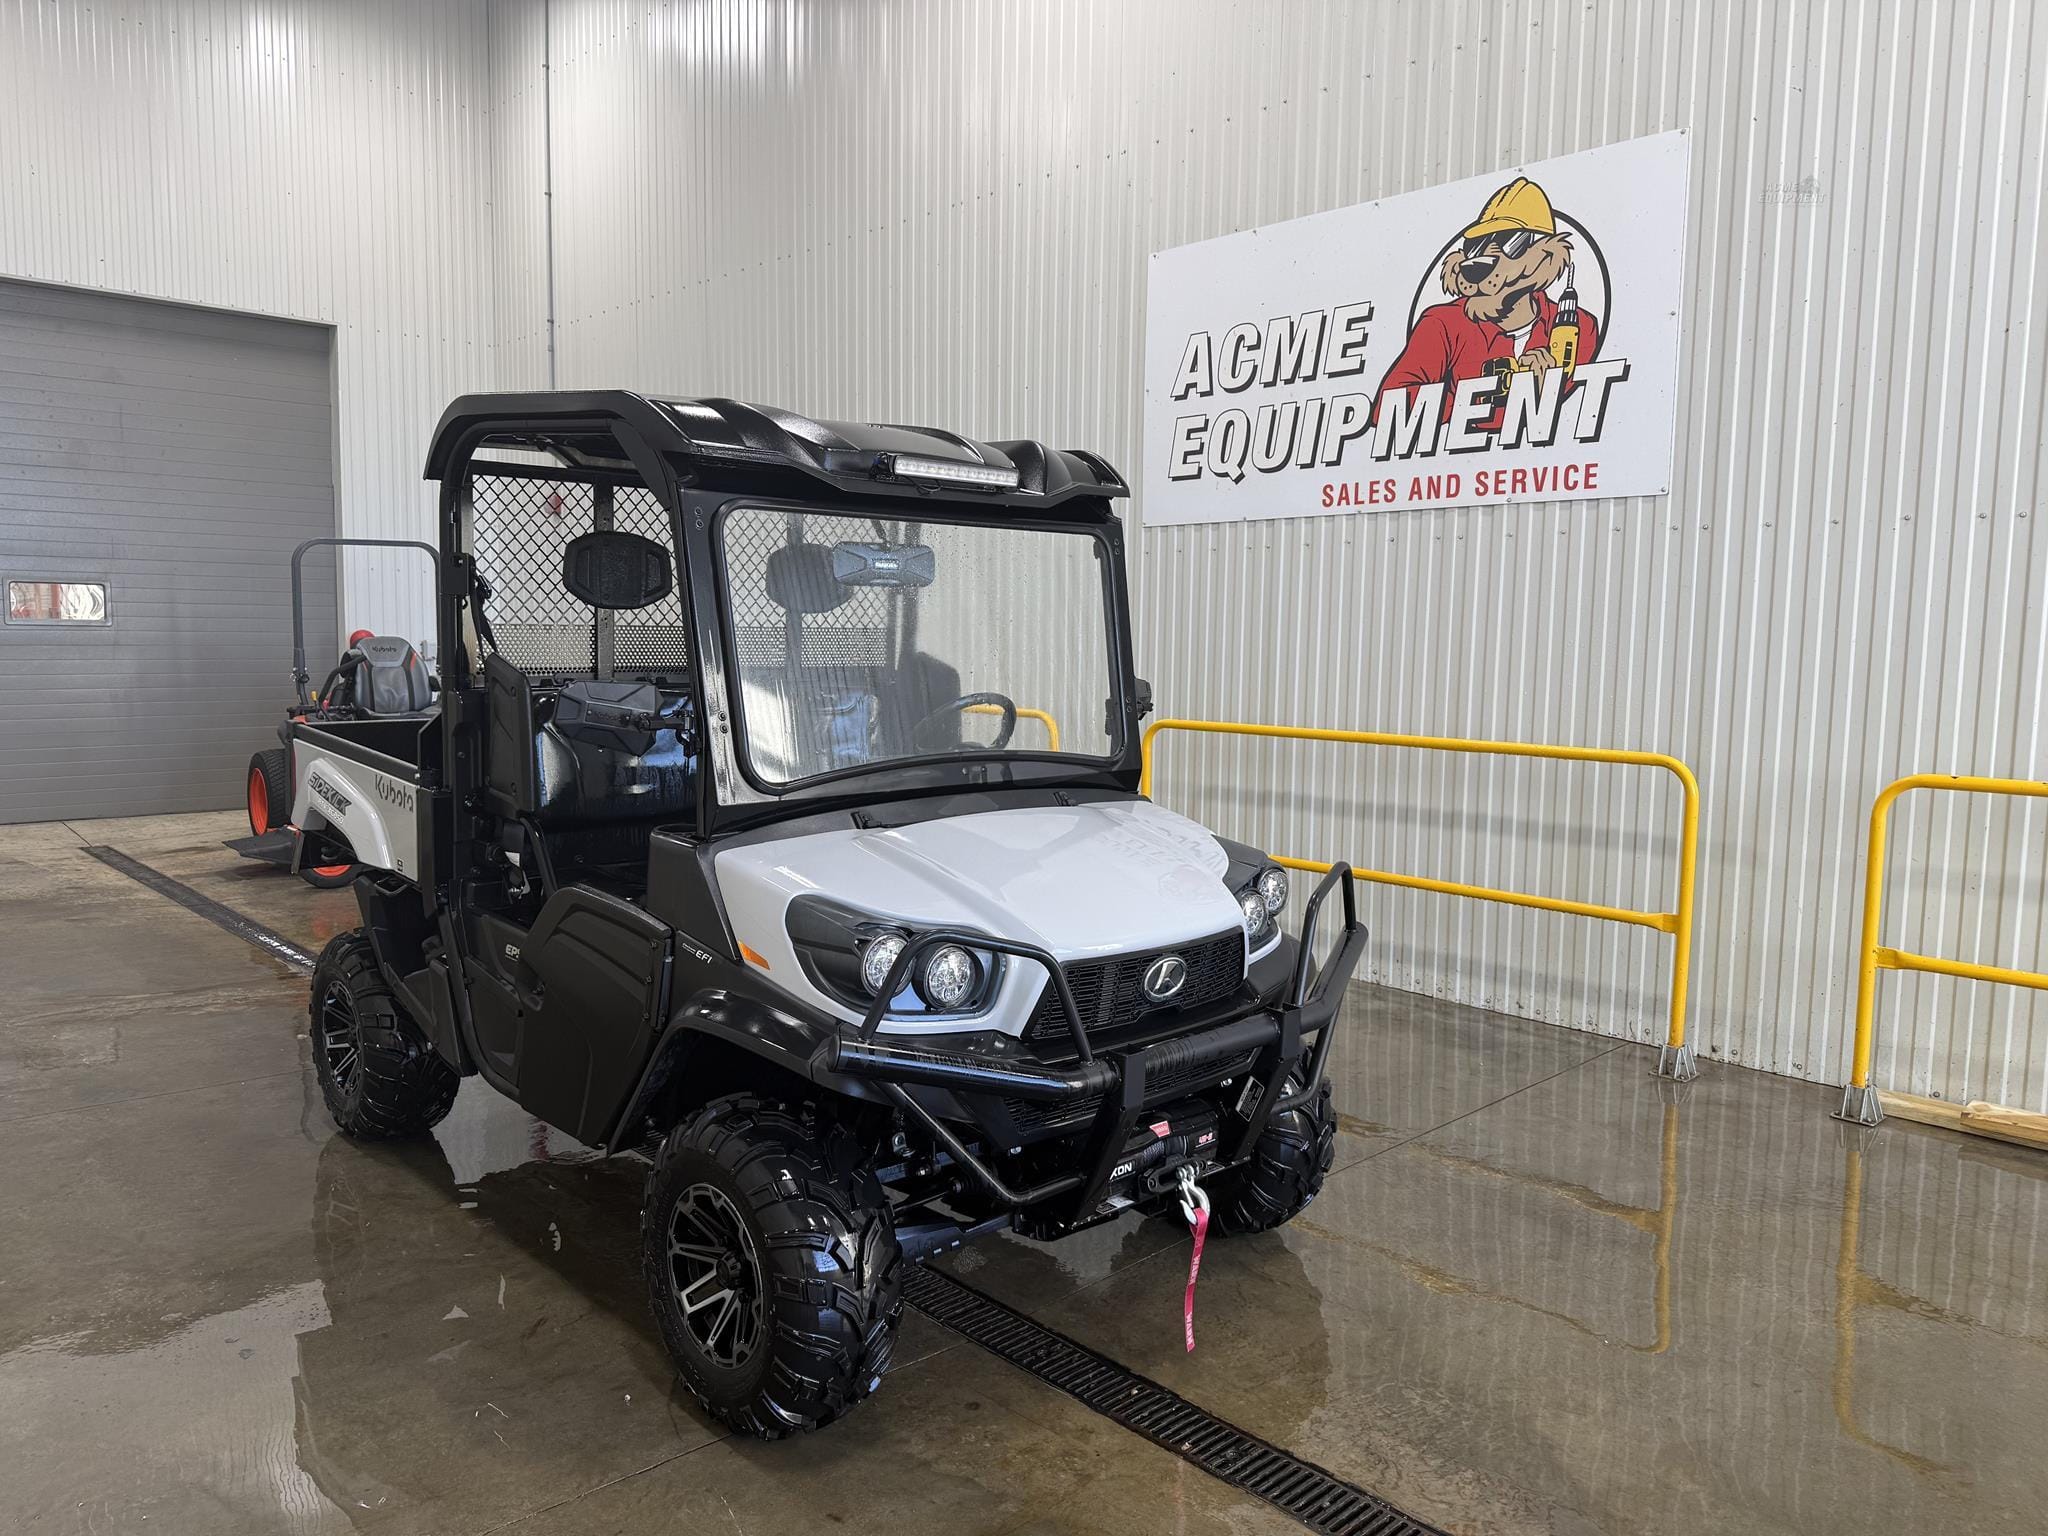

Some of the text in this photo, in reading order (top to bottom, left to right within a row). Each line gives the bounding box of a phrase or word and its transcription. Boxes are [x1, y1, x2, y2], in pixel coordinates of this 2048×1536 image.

[1170, 300, 1374, 400] ACME
[1168, 358, 1631, 484] EQUIPMENT
[1321, 462, 1600, 508] SALES AND SERVICE
[308, 773, 350, 815] SIDEKICK
[374, 773, 414, 813] Kubota
[695, 949, 713, 964] EFI
